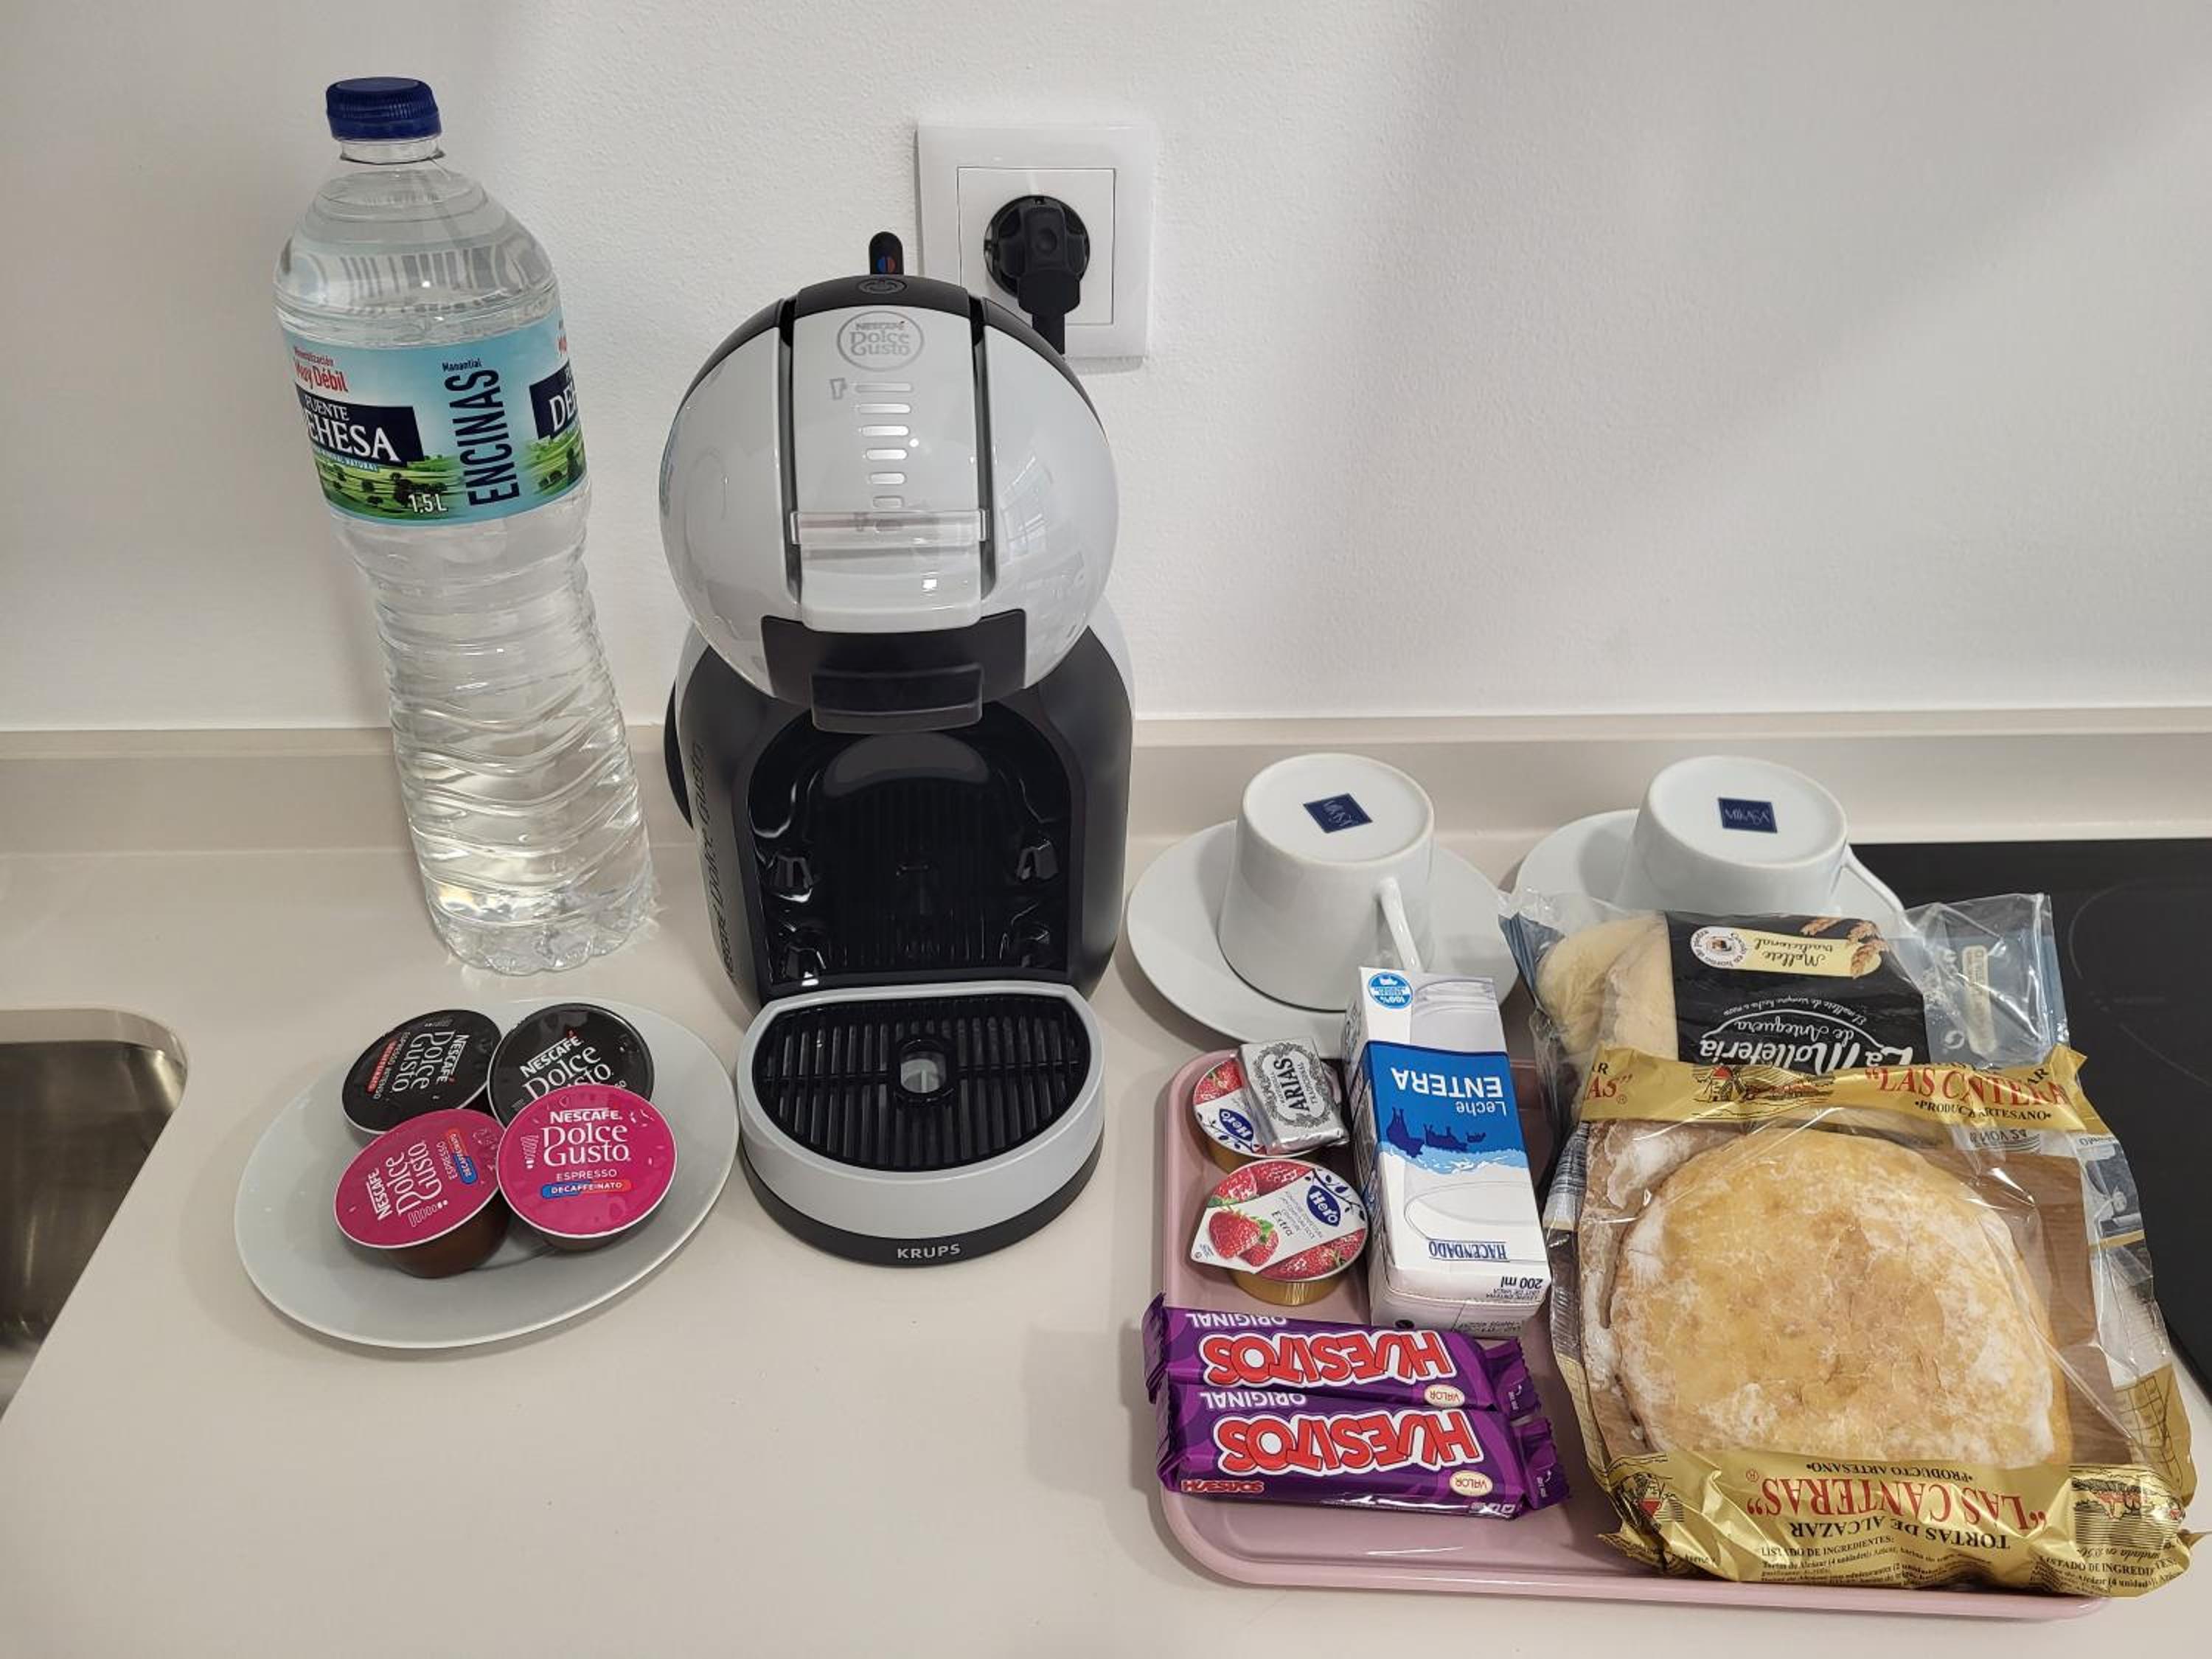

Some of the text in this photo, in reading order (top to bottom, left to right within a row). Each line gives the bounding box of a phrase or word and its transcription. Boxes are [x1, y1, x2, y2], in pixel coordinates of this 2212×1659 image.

[849, 330, 910, 344] Dolce
[850, 341, 911, 356] Gusto
[313, 366, 349, 392] Débil
[302, 408, 402, 462] EHESA
[444, 370, 521, 507] ENCINAS
[1751, 937, 1834, 954] tradicional
[1761, 951, 1826, 967] Mollete
[1733, 1016, 1854, 1046] de Antequera
[392, 1032, 433, 1093] Gusto
[408, 1030, 456, 1090] Dolce
[1865, 1046, 1913, 1068] La
[521, 1046, 601, 1101] Dolce
[569, 1062, 612, 1087] sto
[1273, 1058, 1310, 1112] ARIAS
[1390, 1067, 1504, 1098] ENTERA
[1455, 1101, 1507, 1116] Leche
[540, 1122, 628, 1149] Dolce
[1220, 1110, 1251, 1141] Hero
[436, 1141, 459, 1180] ESPRESSO
[543, 1141, 630, 1167] Gusto
[408, 1139, 443, 1200] Gusto
[556, 1169, 618, 1181] ESPRESSO
[385, 1151, 422, 1216] Dolce
[551, 1181, 623, 1194] DECAFFEINATO
[1309, 1185, 1340, 1224] Hero
[1271, 1210, 1294, 1238] Extra
[897, 1243, 961, 1259] KRUPS
[1428, 1242, 1508, 1260] HACENDADO
[1500, 1276, 1543, 1290] 200 ml
[1186, 1313, 1287, 1328] ORIGINAL
[1201, 1331, 1455, 1387] HUESITOS
[1200, 1391, 1307, 1411] ORIGINAL
[1428, 1388, 1461, 1403] VALOR
[1216, 1410, 1481, 1474] HUESITOS
[1455, 1478, 1488, 1489] VALOR
[1810, 1461, 1969, 1482] PRODUCTO ARTESANO
[1747, 1475, 2046, 1532] “LAS CANTERAS”
[1789, 1514, 2011, 1550] TORTAS DE ALCAZAR
[1806, 1547, 1821, 1557] DE
[1823, 1534, 1895, 1556] INGREDIENTES:
